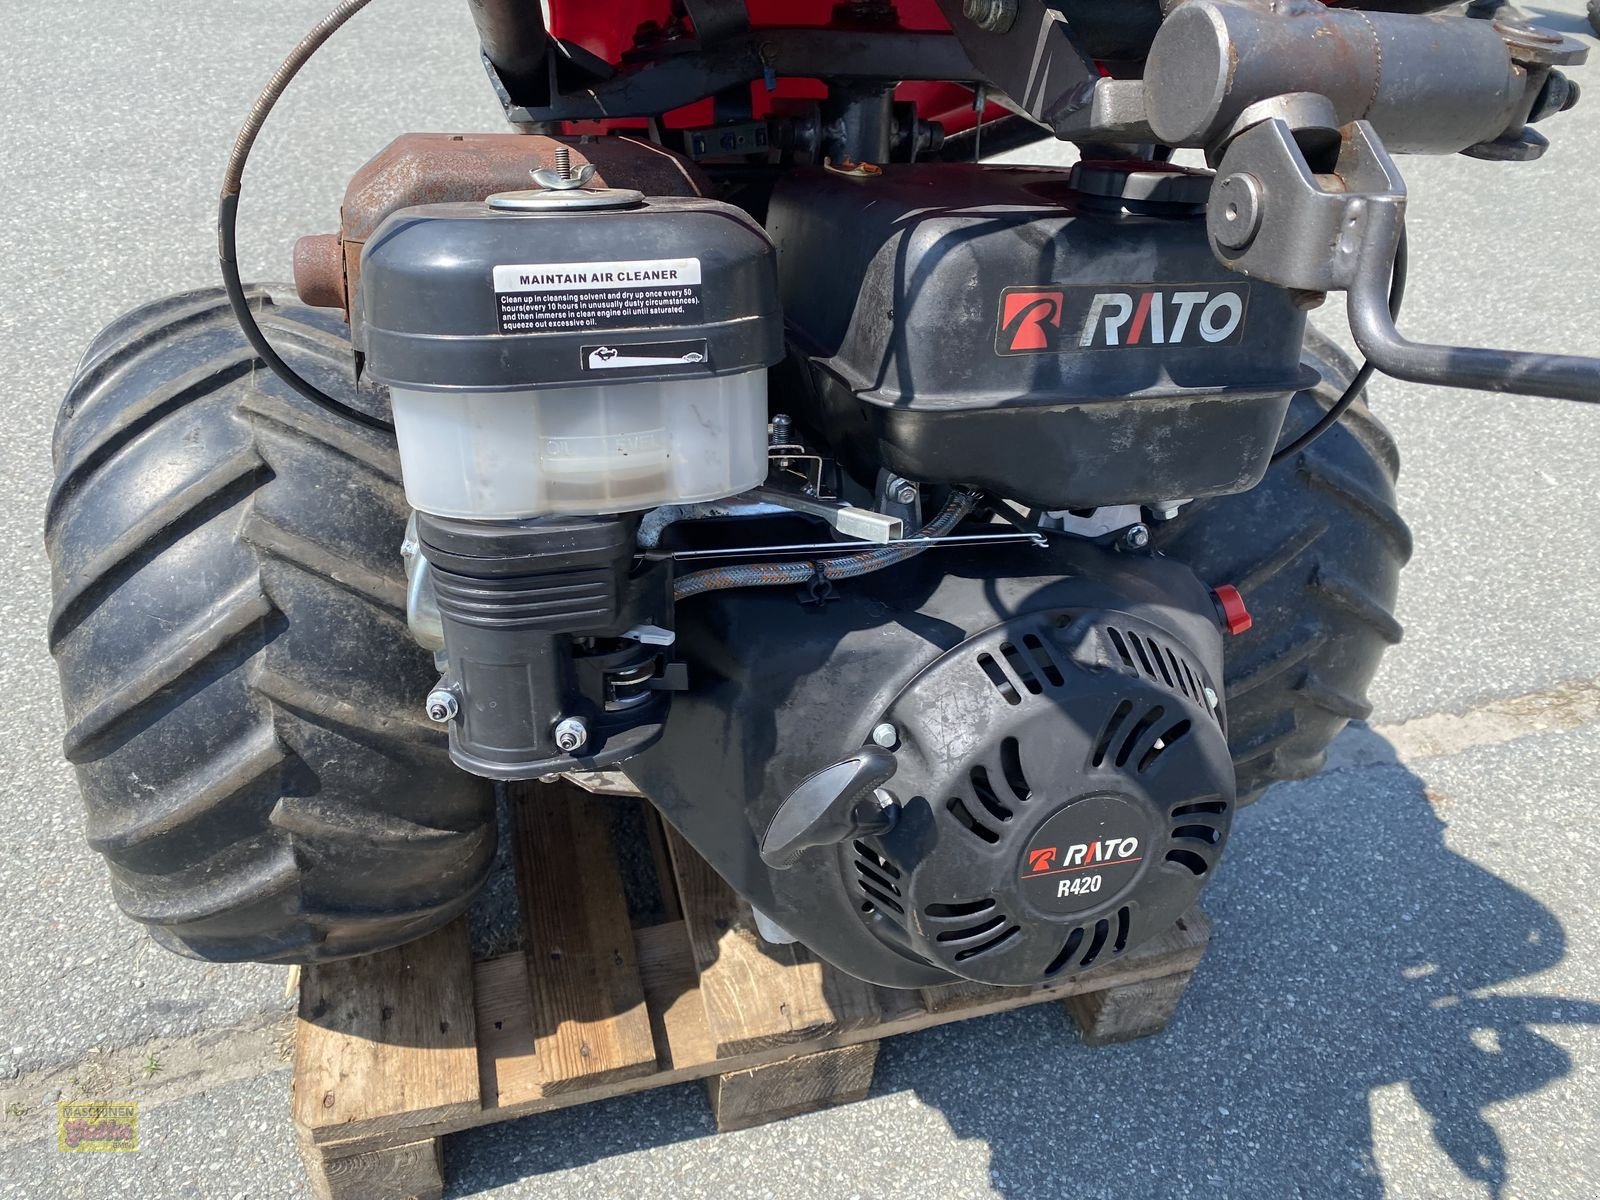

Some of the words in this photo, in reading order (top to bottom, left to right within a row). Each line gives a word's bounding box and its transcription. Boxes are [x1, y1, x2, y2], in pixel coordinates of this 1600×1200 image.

[520, 273, 587, 285] MAINTAIN
[591, 272, 614, 283] AIR
[617, 270, 678, 282] CLEANER
[501, 296, 522, 304] Clean
[534, 295, 541, 303] in
[543, 294, 578, 303] cleansing
[580, 293, 606, 301] solvent
[608, 292, 620, 300] and
[622, 291, 633, 300] dry
[635, 292, 644, 300] up
[663, 290, 682, 298] every
[684, 288, 692, 296] 50
[502, 304, 546, 313] hours(every
[548, 303, 556, 311] 10
[558, 302, 578, 310] hours
[588, 300, 623, 309] unusually
[624, 300, 644, 308] dusty
[502, 313, 516, 321] and
[517, 312, 534, 320] then
[576, 310, 596, 318] clean
[597, 309, 621, 318] engine
[622, 308, 631, 316] oil
[633, 307, 649, 315] until
[503, 322, 534, 330] squeeze
[549, 319, 584, 328] excessive
[586, 318, 597, 326] oil.
[1079, 291, 1243, 347] RATO
[1063, 837, 1139, 867] RATO
[1057, 875, 1102, 898] R420
